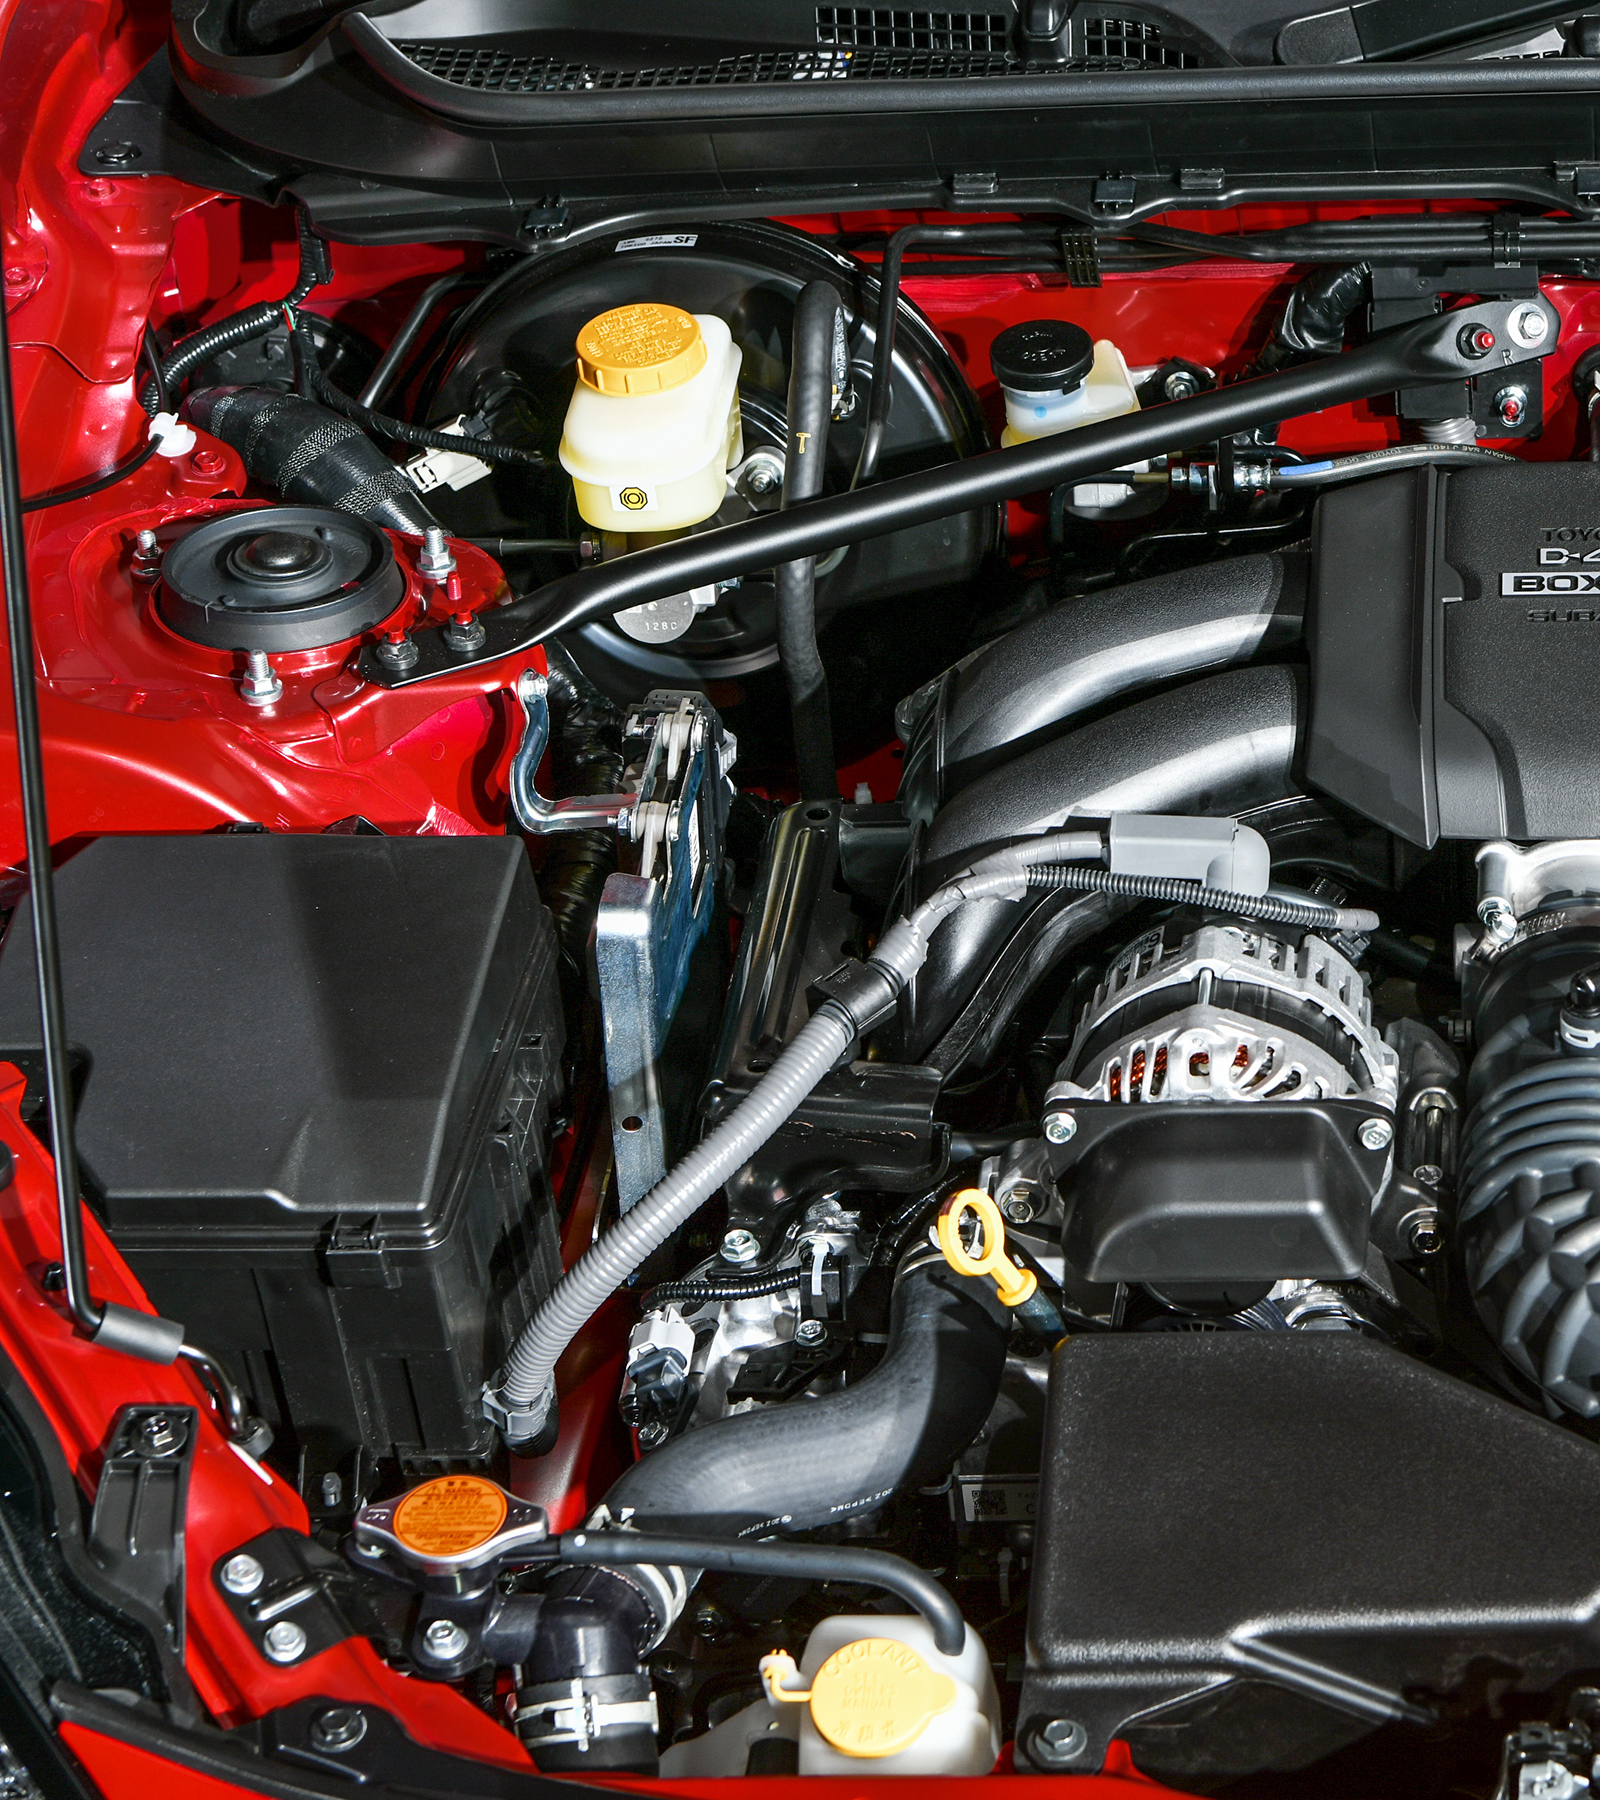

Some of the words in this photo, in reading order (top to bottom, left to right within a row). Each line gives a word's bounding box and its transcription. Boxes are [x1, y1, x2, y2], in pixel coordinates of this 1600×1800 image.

[674, 236, 697, 244] SF
[1501, 349, 1515, 365] R
[796, 433, 811, 454] T
[1484, 449, 1516, 462] JAPAN
[823, 1642, 922, 1676] COOLANT
